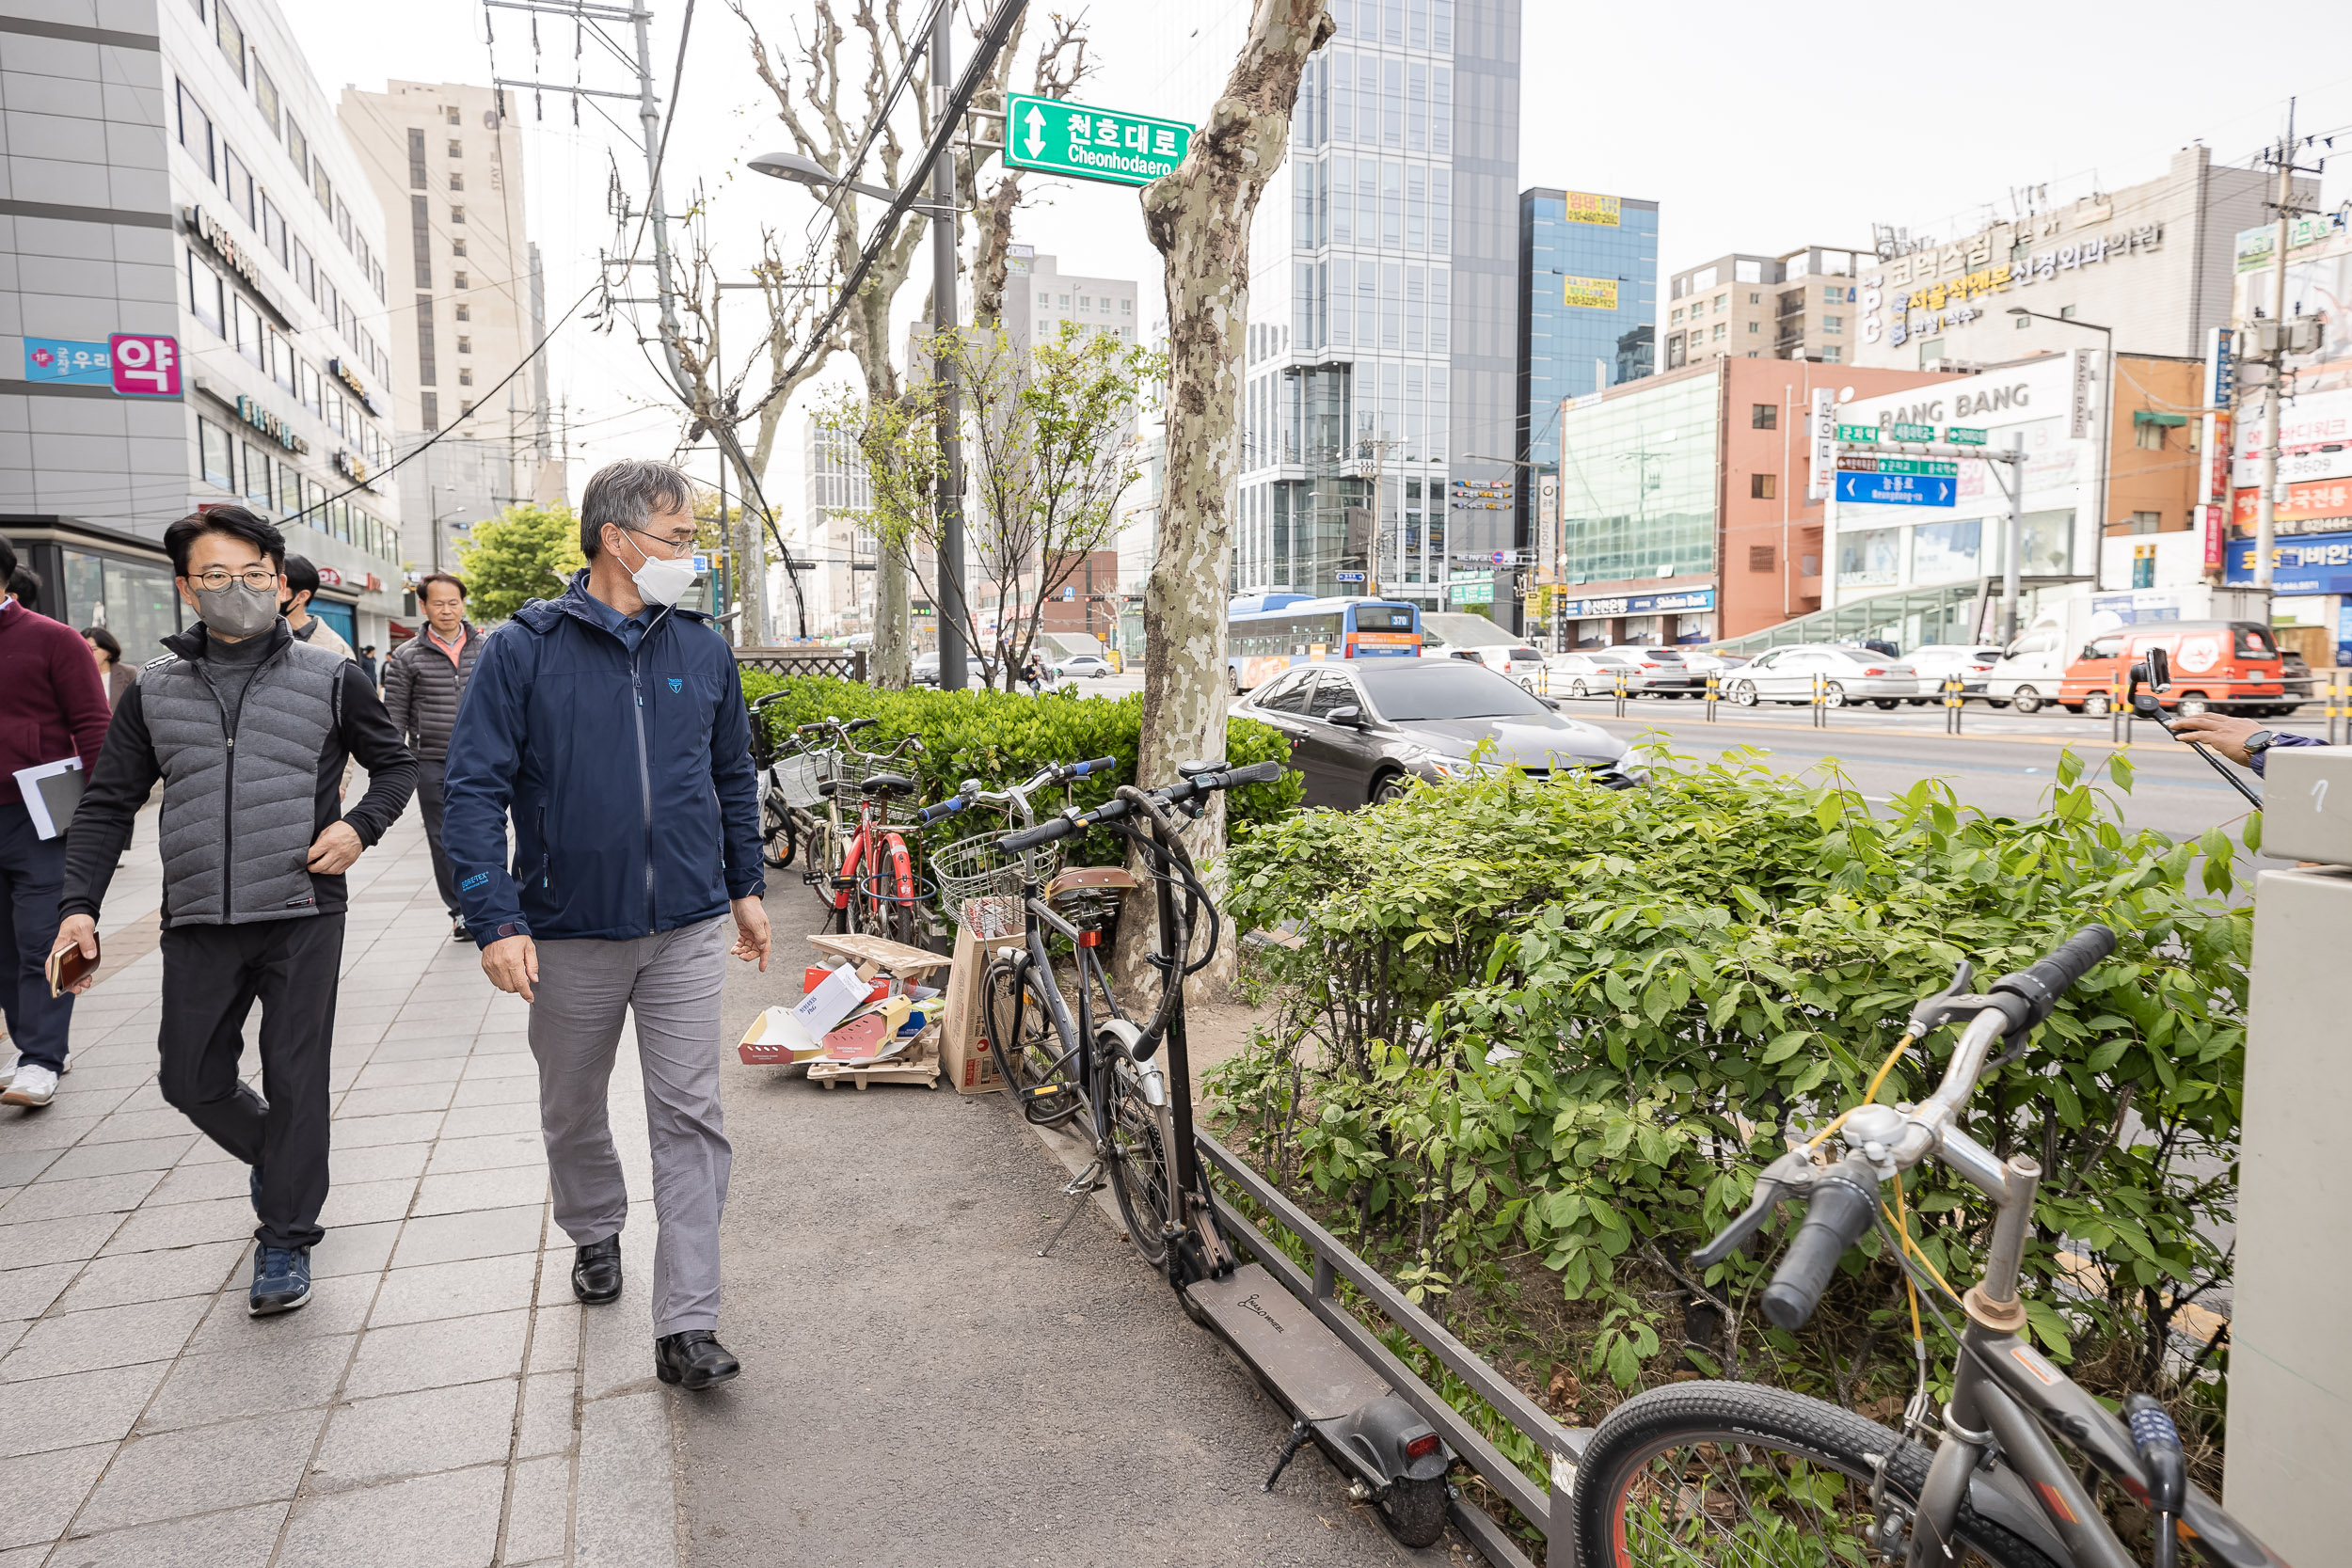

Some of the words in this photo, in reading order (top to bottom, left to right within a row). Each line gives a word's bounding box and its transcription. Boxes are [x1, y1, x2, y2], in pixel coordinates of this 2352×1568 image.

[1067, 114, 1178, 156] 천호대로
[1068, 144, 1171, 176] Cheonhodaero
[1891, 232, 1993, 288] 코엑스짐
[72, 351, 111, 370] 우리
[117, 339, 174, 392] 약
[2076, 355, 2088, 392] BANG
[1880, 400, 1944, 431] BANG
[1956, 383, 2029, 419] BANG
[2075, 395, 2088, 433] BANG
[1841, 427, 1877, 440] 군자역
[1883, 476, 1915, 491] 능동로
[1393, 615, 1407, 626] 370
[1592, 598, 1629, 614] 신한은행
[1295, 644, 1306, 656] 370
